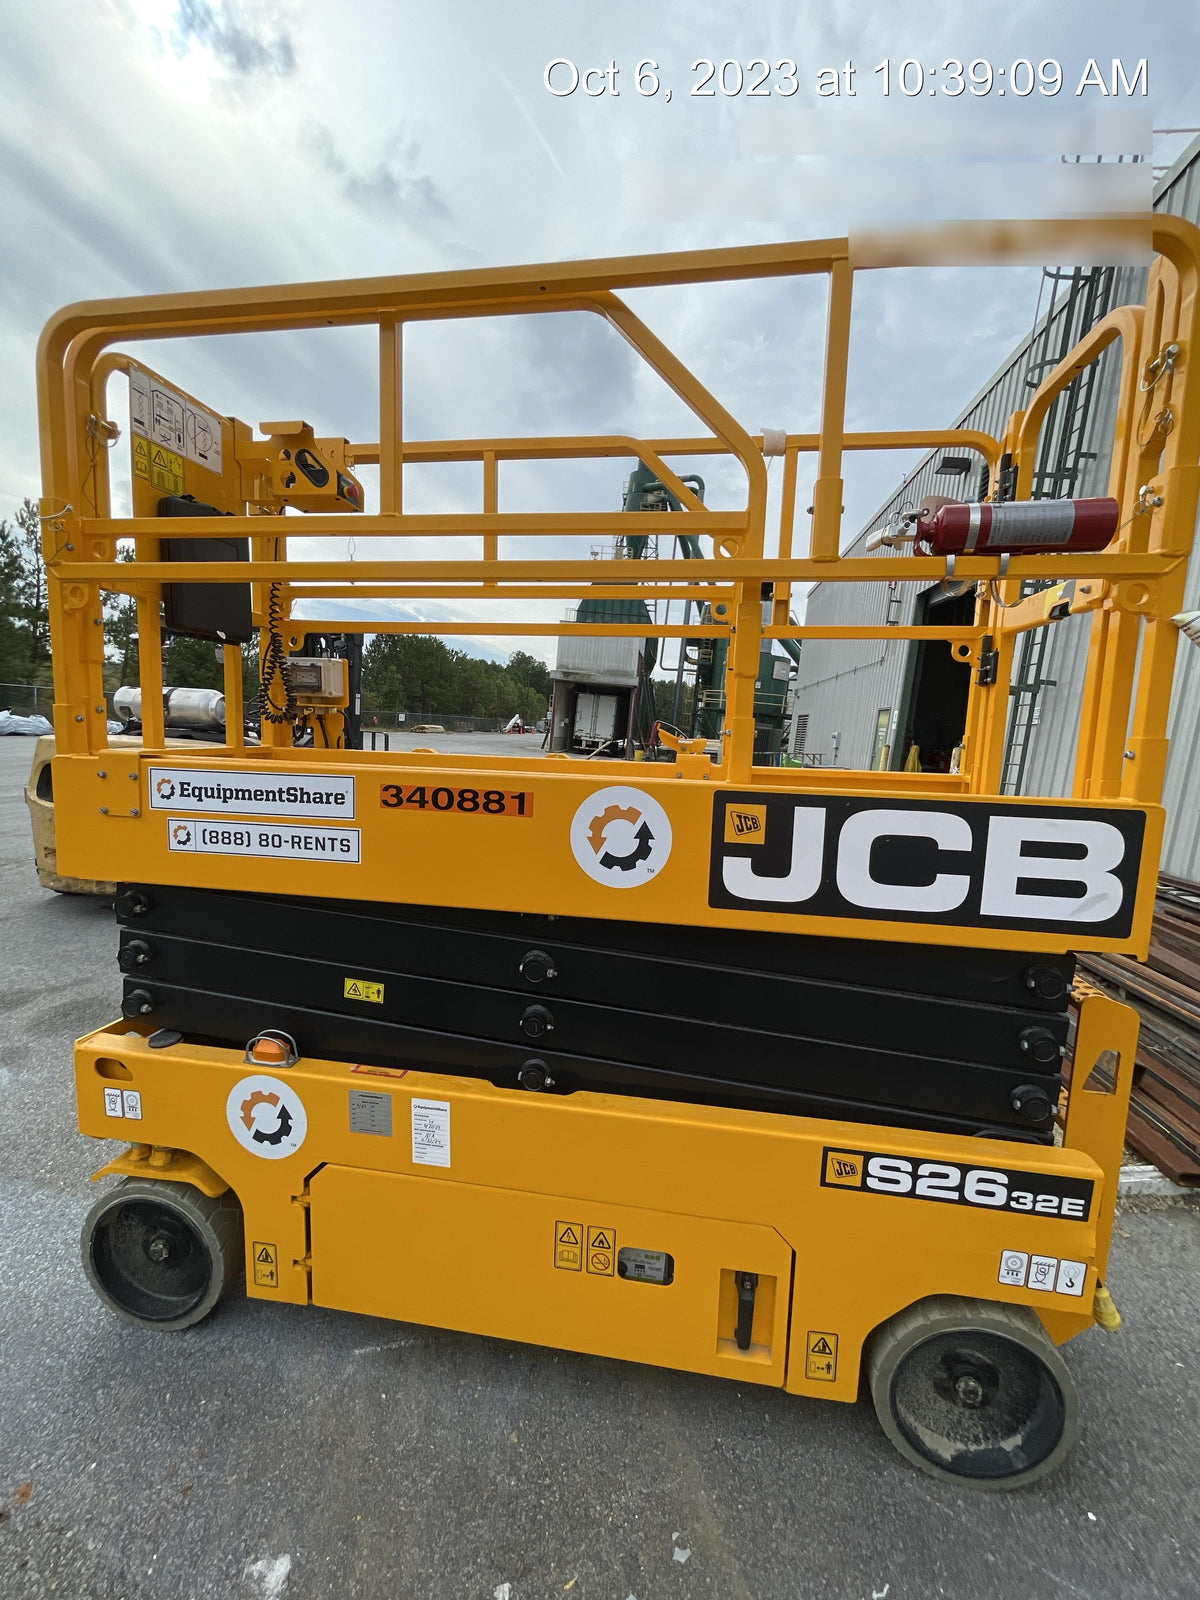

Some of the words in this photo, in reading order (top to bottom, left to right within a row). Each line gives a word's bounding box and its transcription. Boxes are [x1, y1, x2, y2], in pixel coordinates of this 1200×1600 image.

[179, 781, 346, 805] EquipmentShare
[381, 785, 527, 815] 340881
[736, 814, 759, 833] JCB
[202, 828, 251, 847] (888)
[258, 833, 351, 853] 80-RENTS
[722, 806, 1127, 923] JCB
[835, 1160, 857, 1176] JCB
